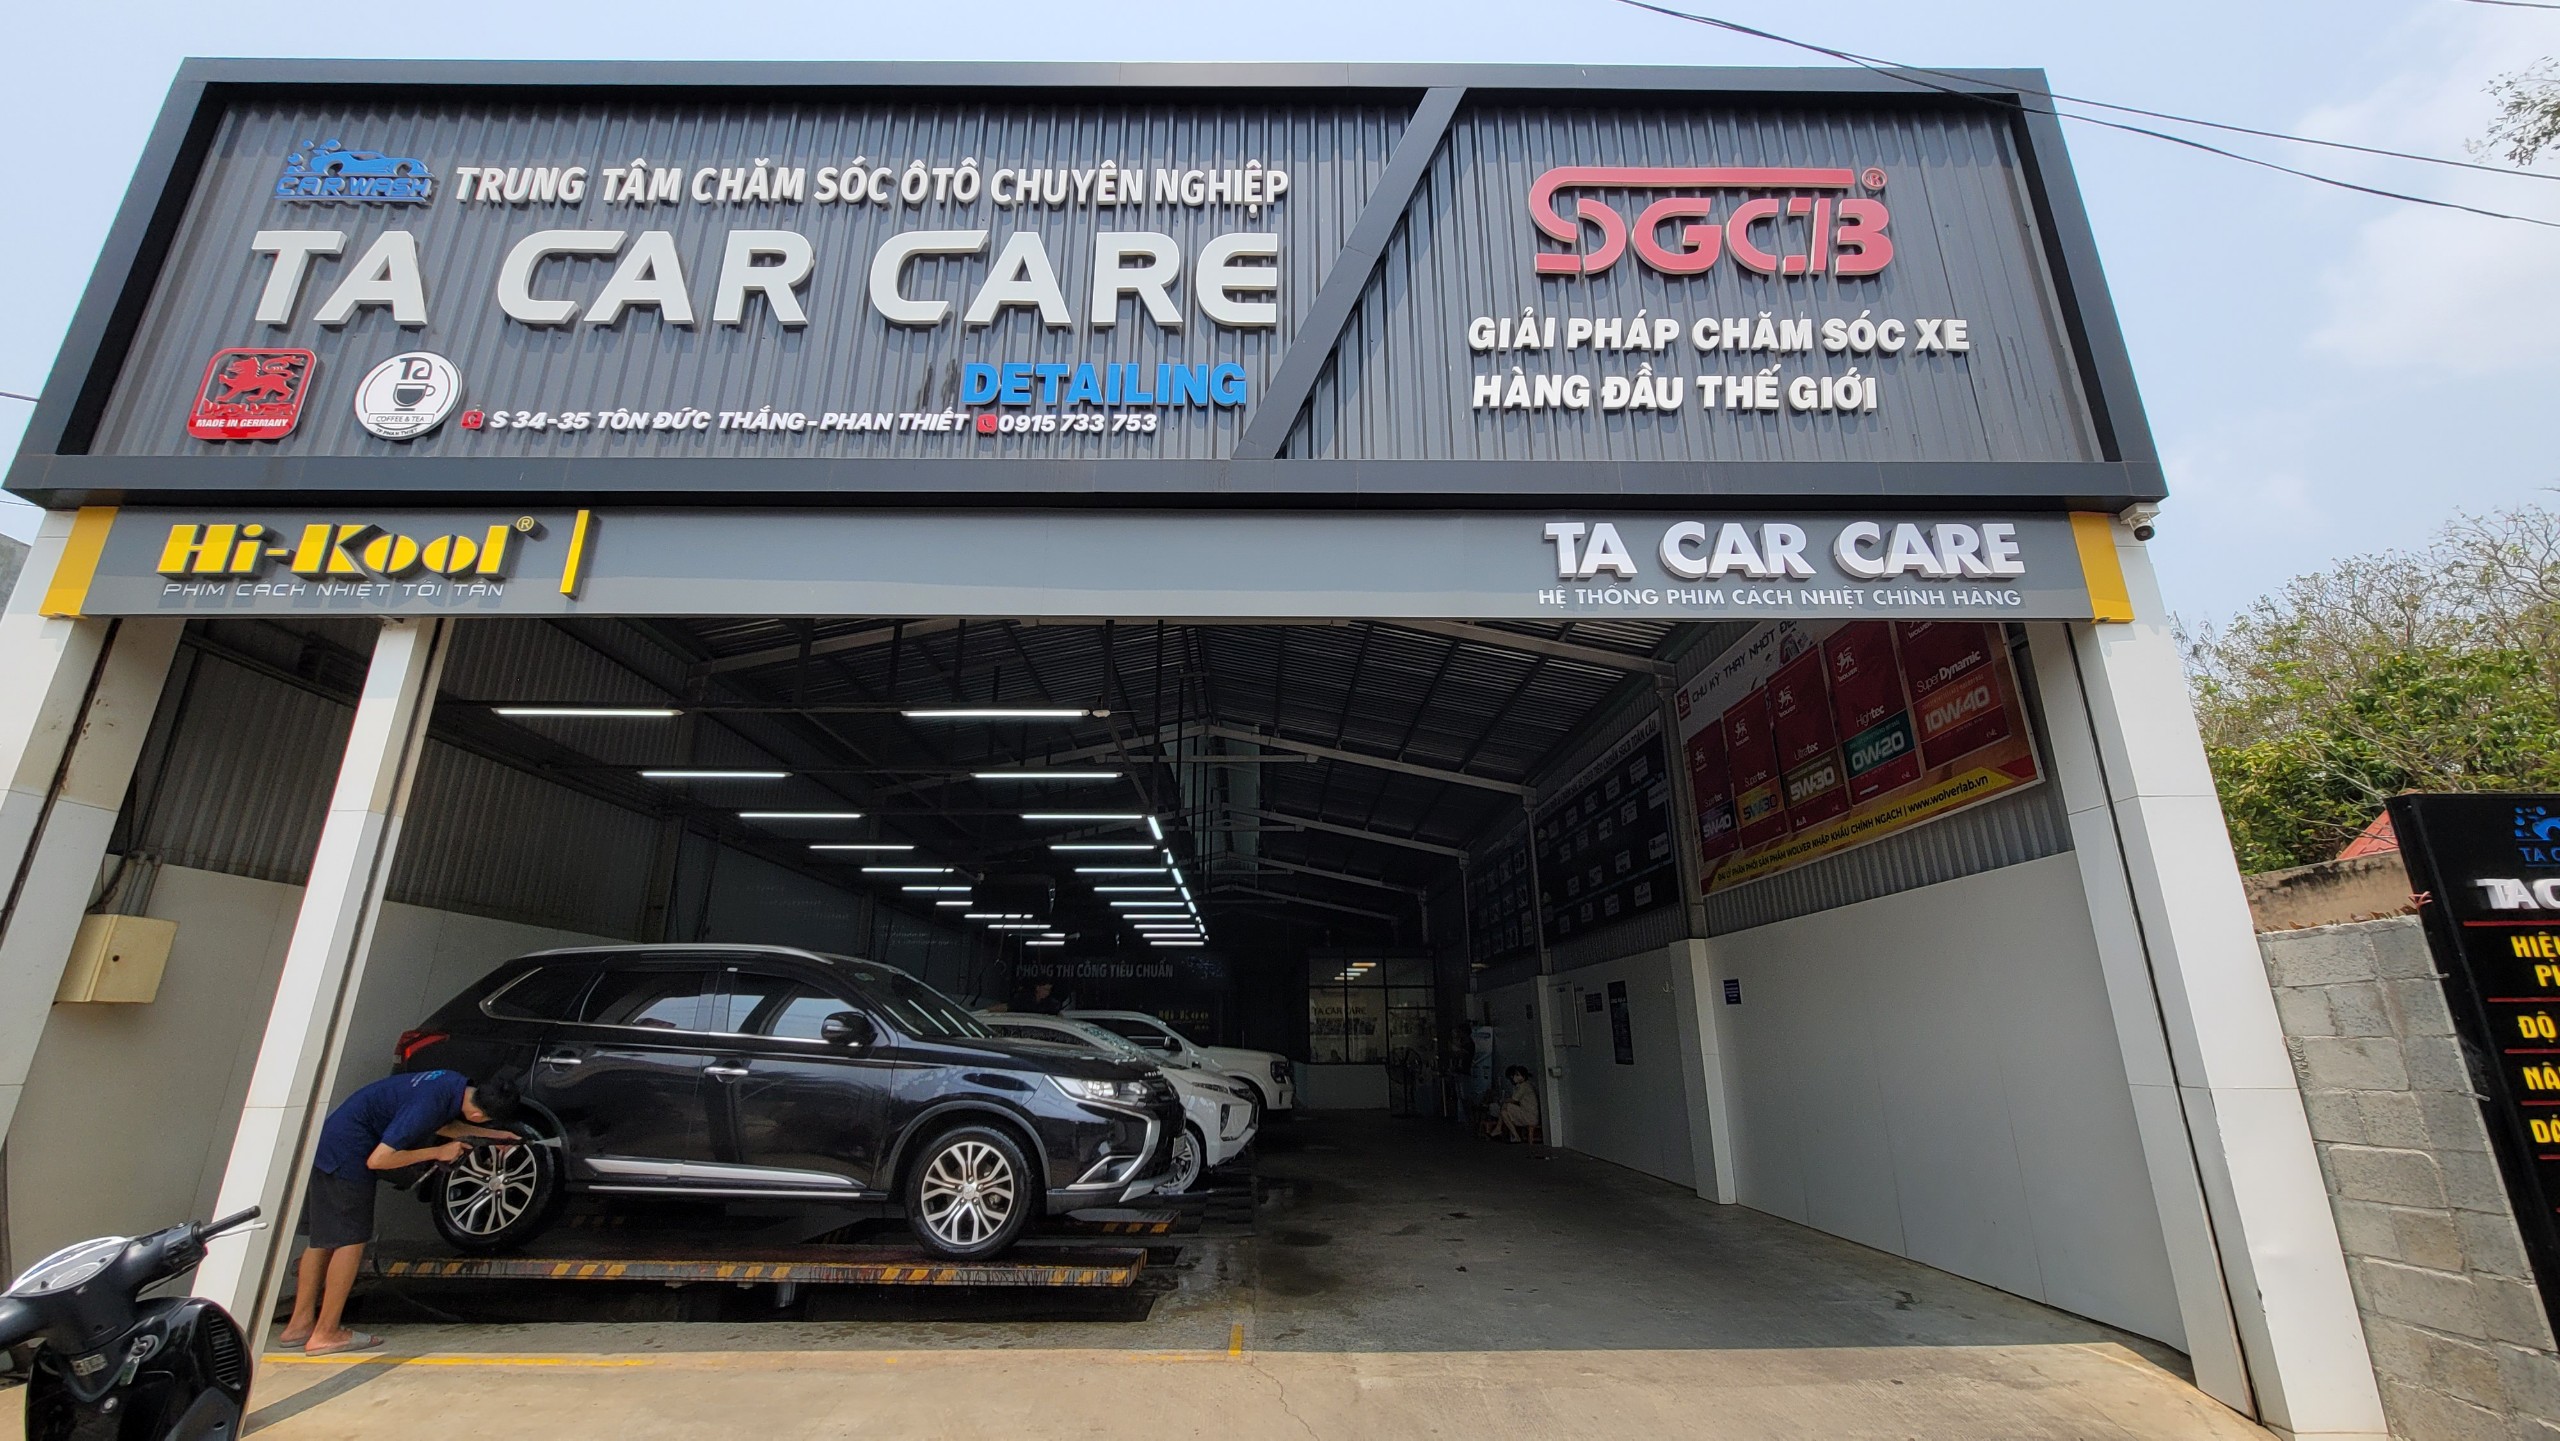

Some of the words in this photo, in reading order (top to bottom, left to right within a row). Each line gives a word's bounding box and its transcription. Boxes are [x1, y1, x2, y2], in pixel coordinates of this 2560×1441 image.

[276, 177, 346, 197] CAR
[350, 177, 433, 198] WASH
[456, 165, 588, 203] TRUNG
[602, 157, 682, 203] TÂM
[692, 157, 806, 203] CHĂM
[814, 155, 893, 203] SÓC
[991, 159, 1144, 206] CHUYÊN
[1155, 159, 1289, 219] NGHIỆP
[251, 229, 428, 326] TA
[497, 229, 815, 326] CAR
[869, 230, 1279, 328] CARE
[1468, 306, 1557, 352] GIẢI
[1567, 309, 1680, 352] PHÁP
[1692, 310, 1814, 353] CHĂM
[1822, 310, 1906, 353] SÓC
[1915, 318, 1970, 353] XE
[962, 362, 1248, 407] DETAILING
[1472, 366, 1590, 411] HÀNG
[1601, 362, 1684, 412] ĐẦU
[1696, 364, 1781, 411] THẾ
[1788, 367, 1878, 414] GIỚI
[196, 418, 226, 428] MADE
[227, 418, 238, 428] IN
[240, 418, 289, 428] GERMANY
[376, 415, 403, 423] COFFEE
[411, 415, 425, 423] TEA
[512, 411, 591, 431] 34-35
[597, 407, 650, 430] TÔN
[652, 406, 712, 431] ĐỨC
[819, 412, 892, 431] PHAN
[899, 406, 971, 432] THIẾT
[998, 413, 1056, 432] 0915
[1059, 413, 1106, 433] 733
[1111, 413, 1158, 433] 753
[155, 522, 517, 578] Hi-Kool
[1543, 521, 1638, 578] TA
[1659, 520, 1817, 579] CAR
[1834, 521, 2026, 579] CARE
[163, 582, 226, 597] PHIM
[235, 580, 306, 597] CÁCH
[316, 580, 392, 599] NHIỆT
[402, 578, 442, 597] TỐI
[1538, 584, 1567, 608] HỆ
[1575, 582, 1660, 606] THỐNG
[1666, 589, 1725, 606] PHIM
[1732, 584, 1793, 606] CÁCH
[1801, 584, 1865, 610] NHIỆT
[1872, 584, 1946, 607] CHÍNH
[1722, 653, 1747, 679] THAY
[1916, 673, 1940, 694] Super
[1939, 650, 1982, 681] Dynamic
[1855, 704, 1885, 728] Hightec
[1786, 842, 1812, 858] WOLVER
[1811, 834, 1830, 849] NHẬP
[1830, 825, 1851, 842] KHẨU
[1850, 819, 1874, 836] CHÍNH
[1874, 806, 1903, 826] NGẠCH
[1908, 774, 1990, 814] www.wolverlab.vn
[2510, 931, 2560, 962] HIỆ
[1135, 956, 1174, 978] CHUẨN
[2518, 1010, 2557, 1043] ĐỘ
